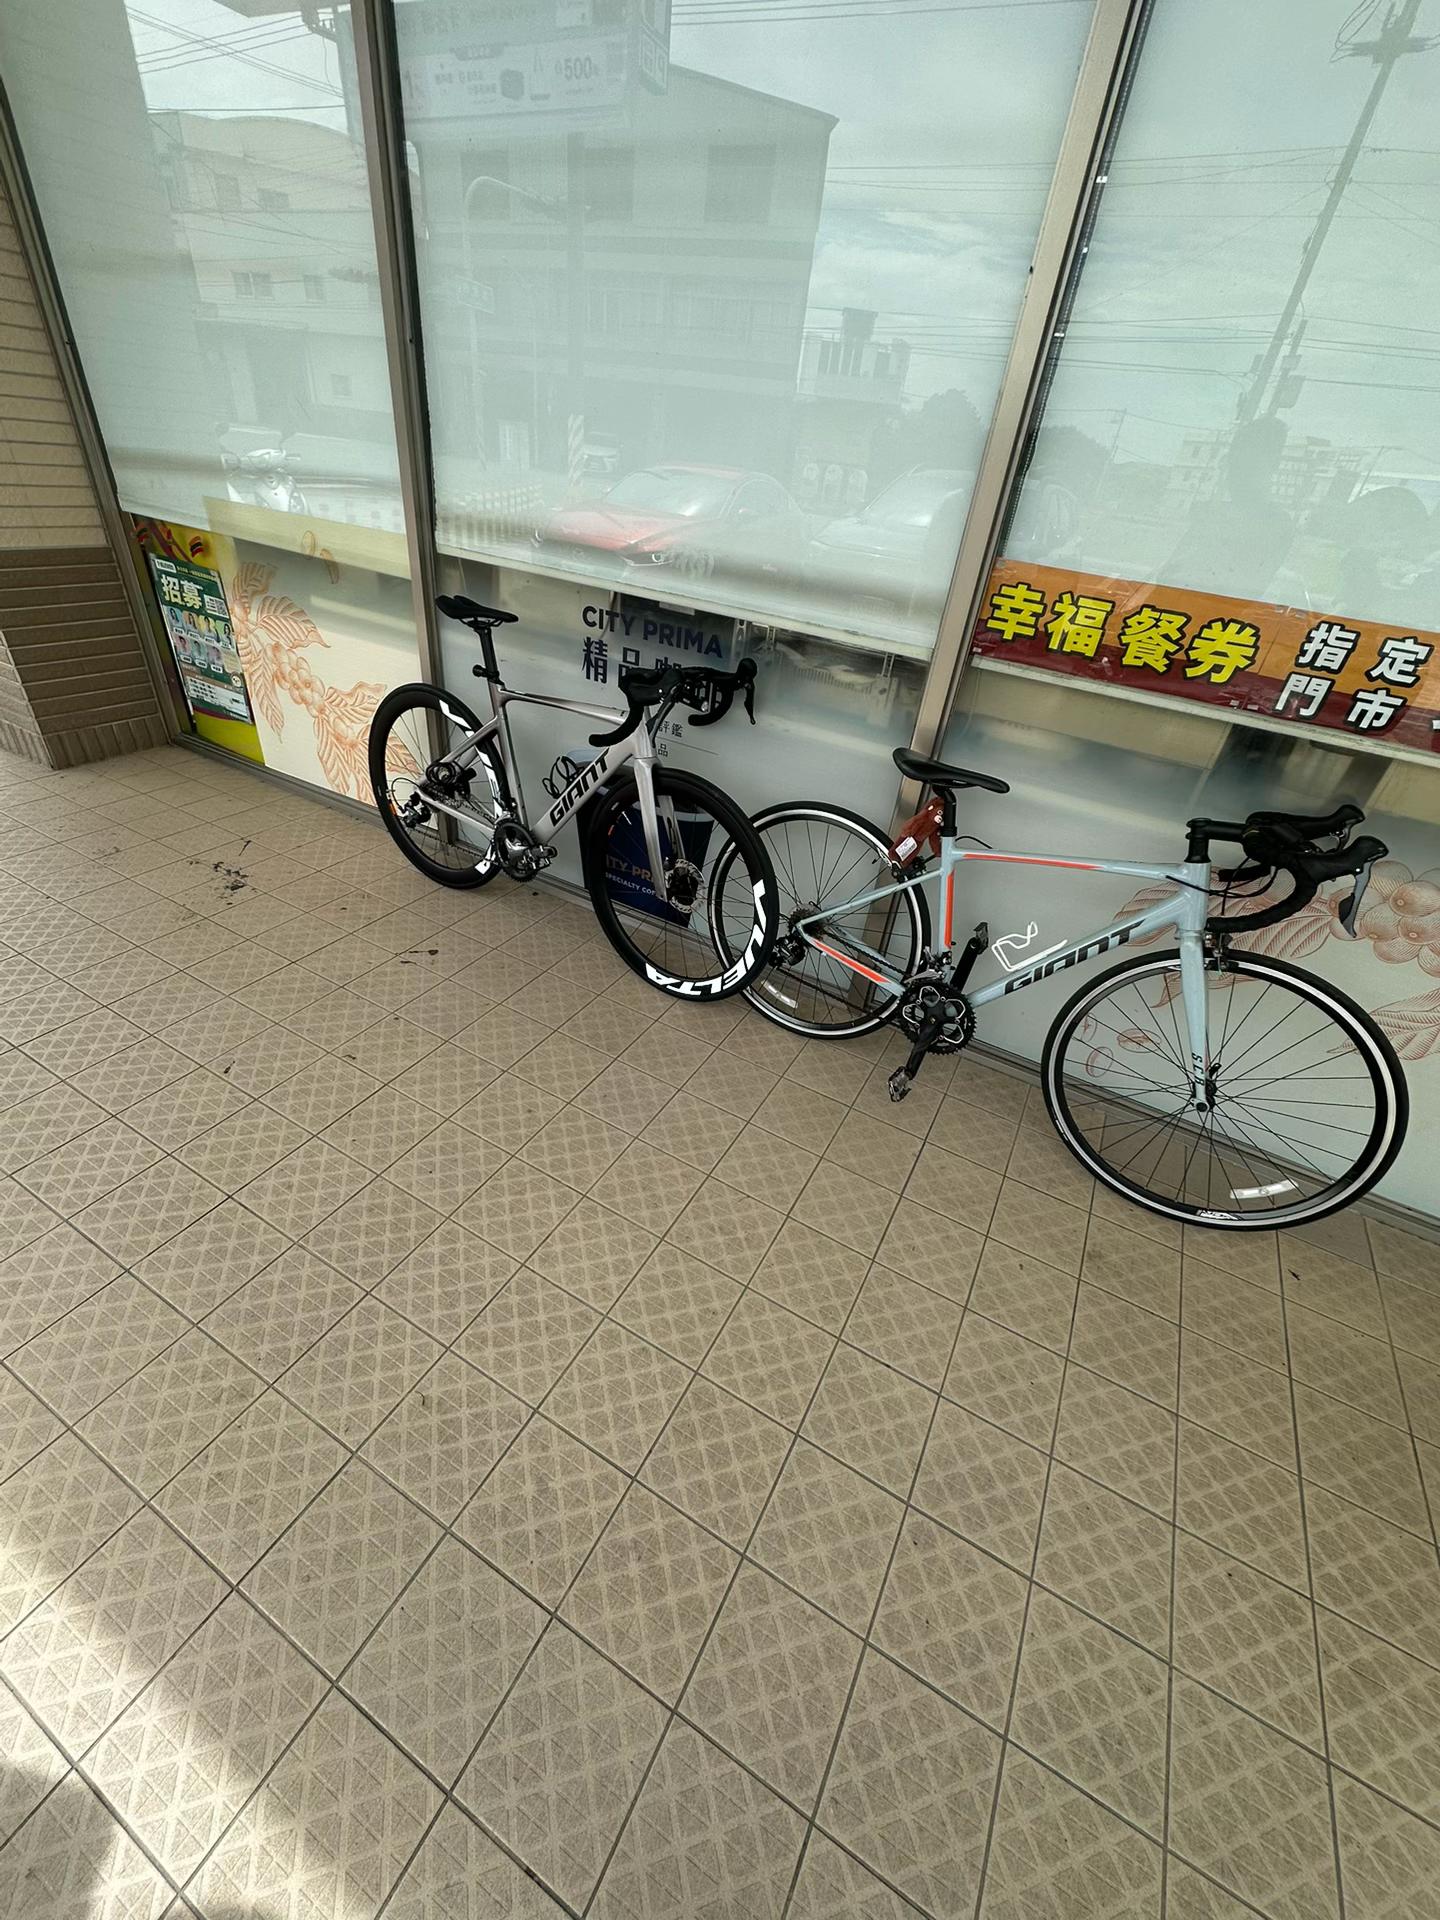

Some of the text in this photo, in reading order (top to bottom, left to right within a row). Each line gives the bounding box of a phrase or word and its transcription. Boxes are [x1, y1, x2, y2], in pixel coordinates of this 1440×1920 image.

[161, 573, 204, 609] 招募
[582, 605, 723, 659] CITY PRIMA
[985, 581, 1262, 685] 幸福餐券
[1296, 621, 1433, 686] 指定
[1273, 672, 1408, 732] 門市
[549, 748, 611, 827] GIANT
[1004, 918, 1147, 995] GIANT
